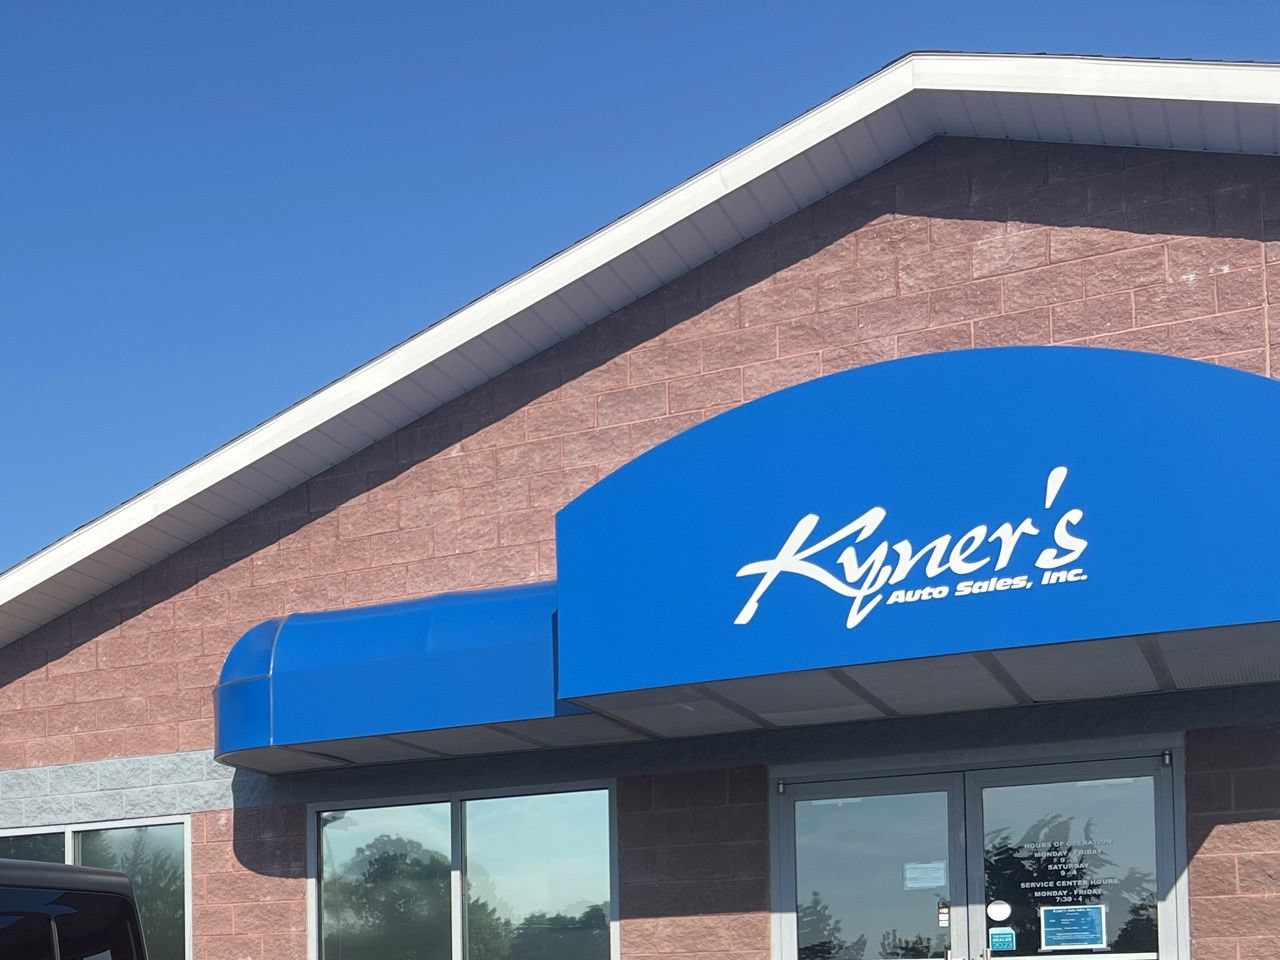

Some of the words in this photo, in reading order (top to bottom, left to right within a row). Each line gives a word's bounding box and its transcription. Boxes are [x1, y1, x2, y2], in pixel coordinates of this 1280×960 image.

[733, 466, 1088, 629] Kyner's
[886, 586, 949, 605] Auto
[955, 575, 1033, 596] Sales,
[1041, 568, 1088, 585] Inc.
[1024, 841, 1051, 849] HOURS
[1053, 840, 1063, 848] OF
[1066, 839, 1113, 847] OPERATION
[1034, 850, 1068, 858] MONDAY
[1073, 848, 1102, 856] FRIDAY
[1047, 863, 1089, 871] SATURDAY
[1020, 881, 1054, 889] SERVICE
